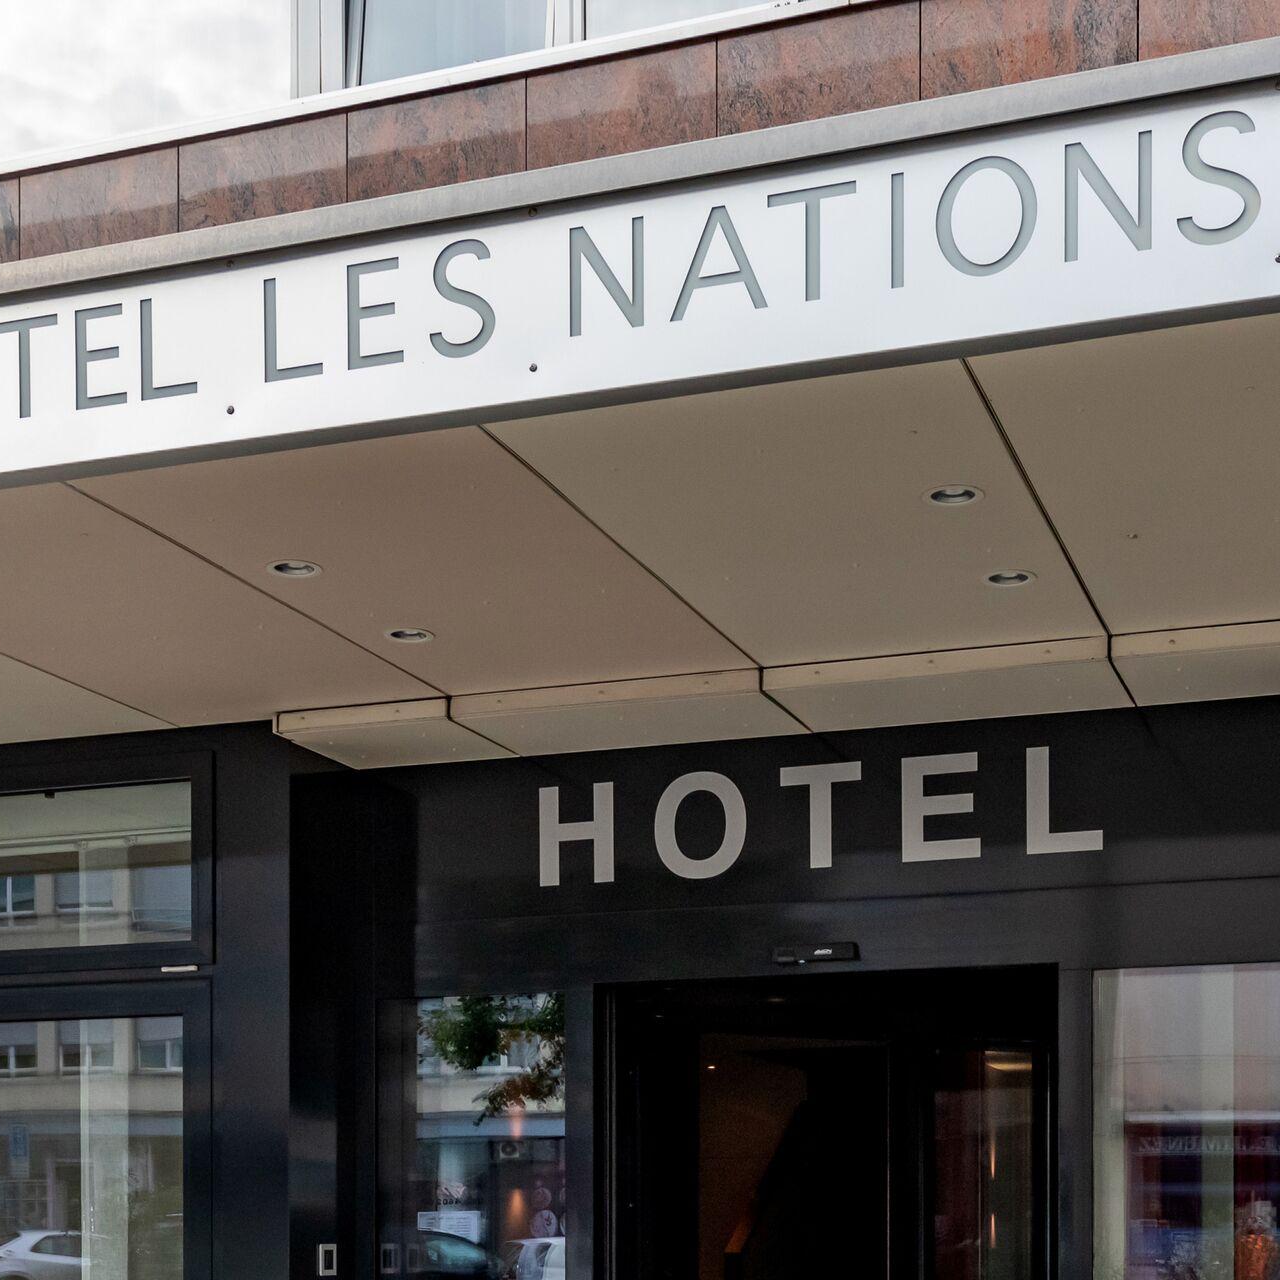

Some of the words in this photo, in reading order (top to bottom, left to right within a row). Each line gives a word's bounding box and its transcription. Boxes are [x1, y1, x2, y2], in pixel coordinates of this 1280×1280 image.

[263, 238, 496, 384] LES
[568, 109, 1262, 339] NATIONS
[538, 746, 1104, 887] HOTEL
